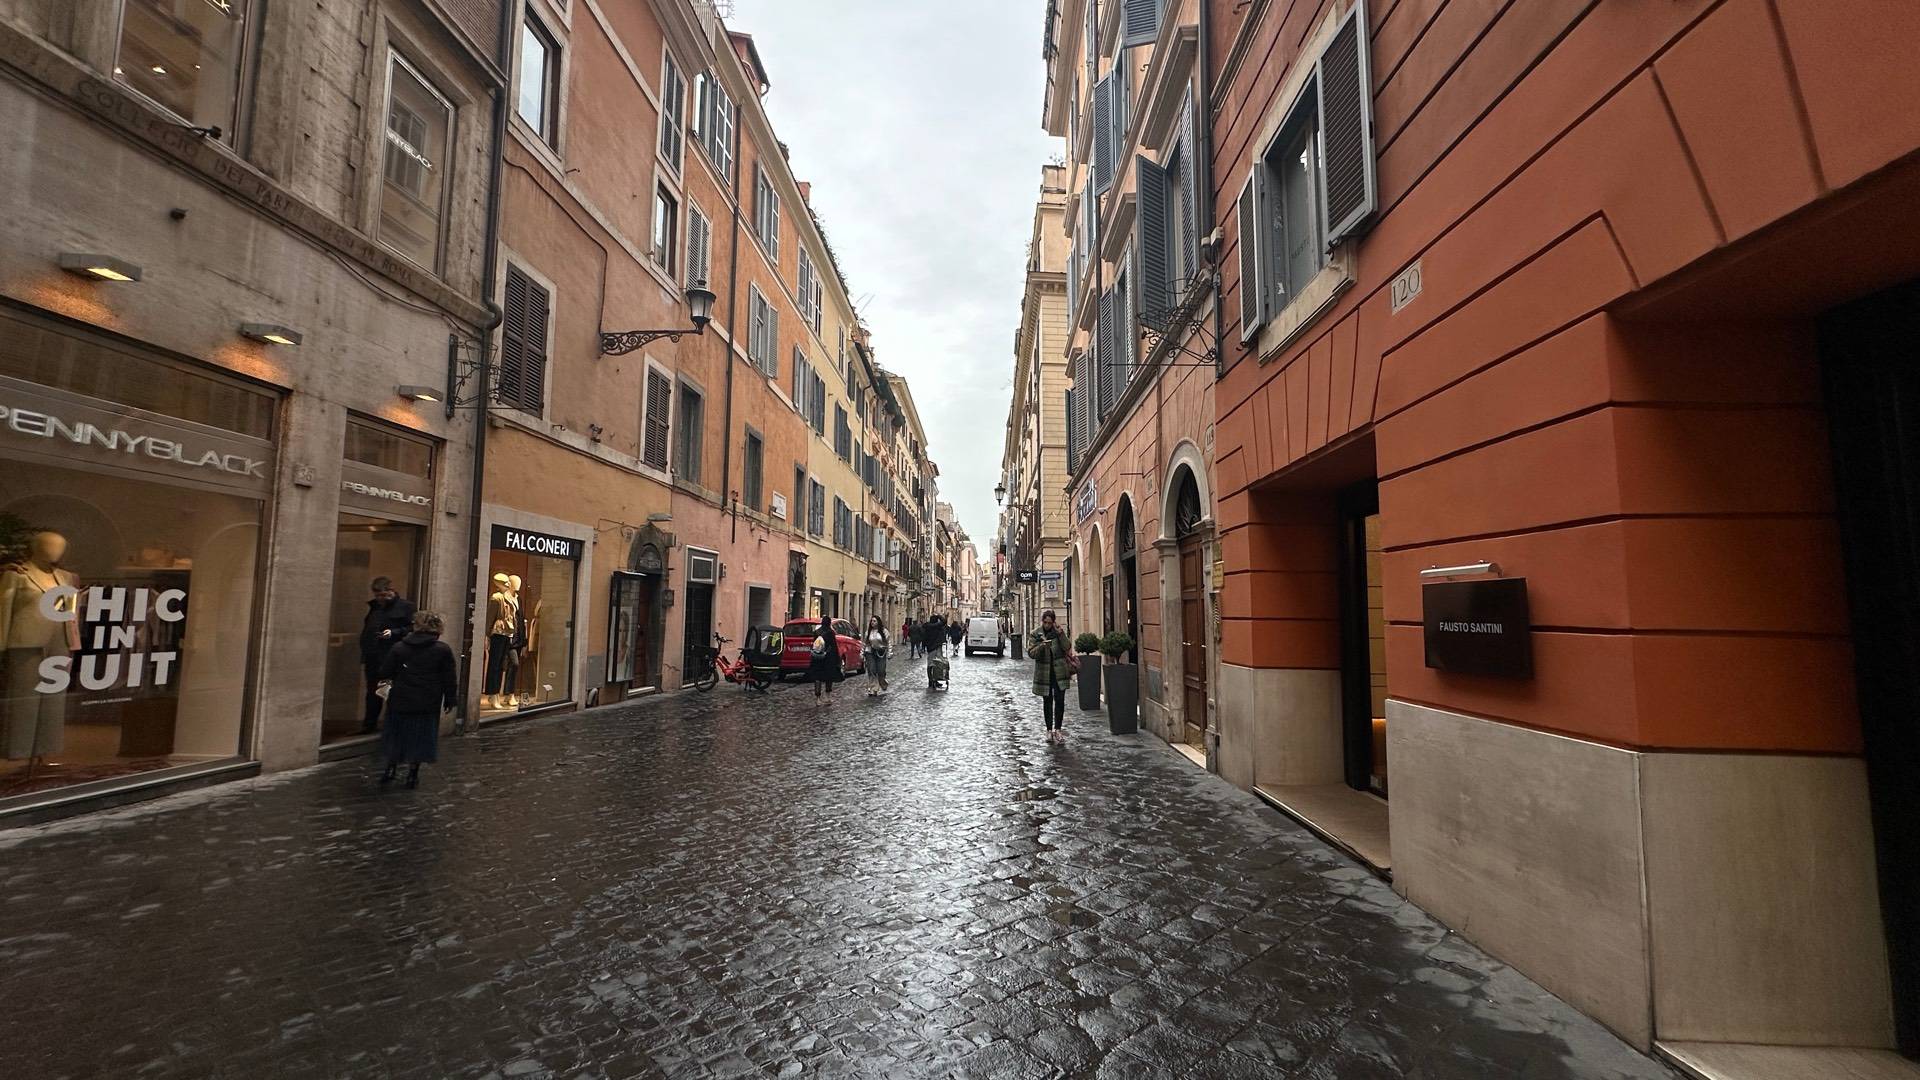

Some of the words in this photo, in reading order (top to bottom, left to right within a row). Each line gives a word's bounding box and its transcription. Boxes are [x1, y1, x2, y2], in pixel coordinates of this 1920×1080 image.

[1393, 268, 1420, 308] 120
[341, 480, 432, 506] PENNYBLACK
[506, 531, 570, 556] FALCONERI
[39, 584, 187, 623] CHIC
[93, 625, 136, 650] IN
[1439, 621, 1469, 633] FAUSTO
[1470, 622, 1503, 634] SANTINI
[34, 651, 177, 694] SUIT
